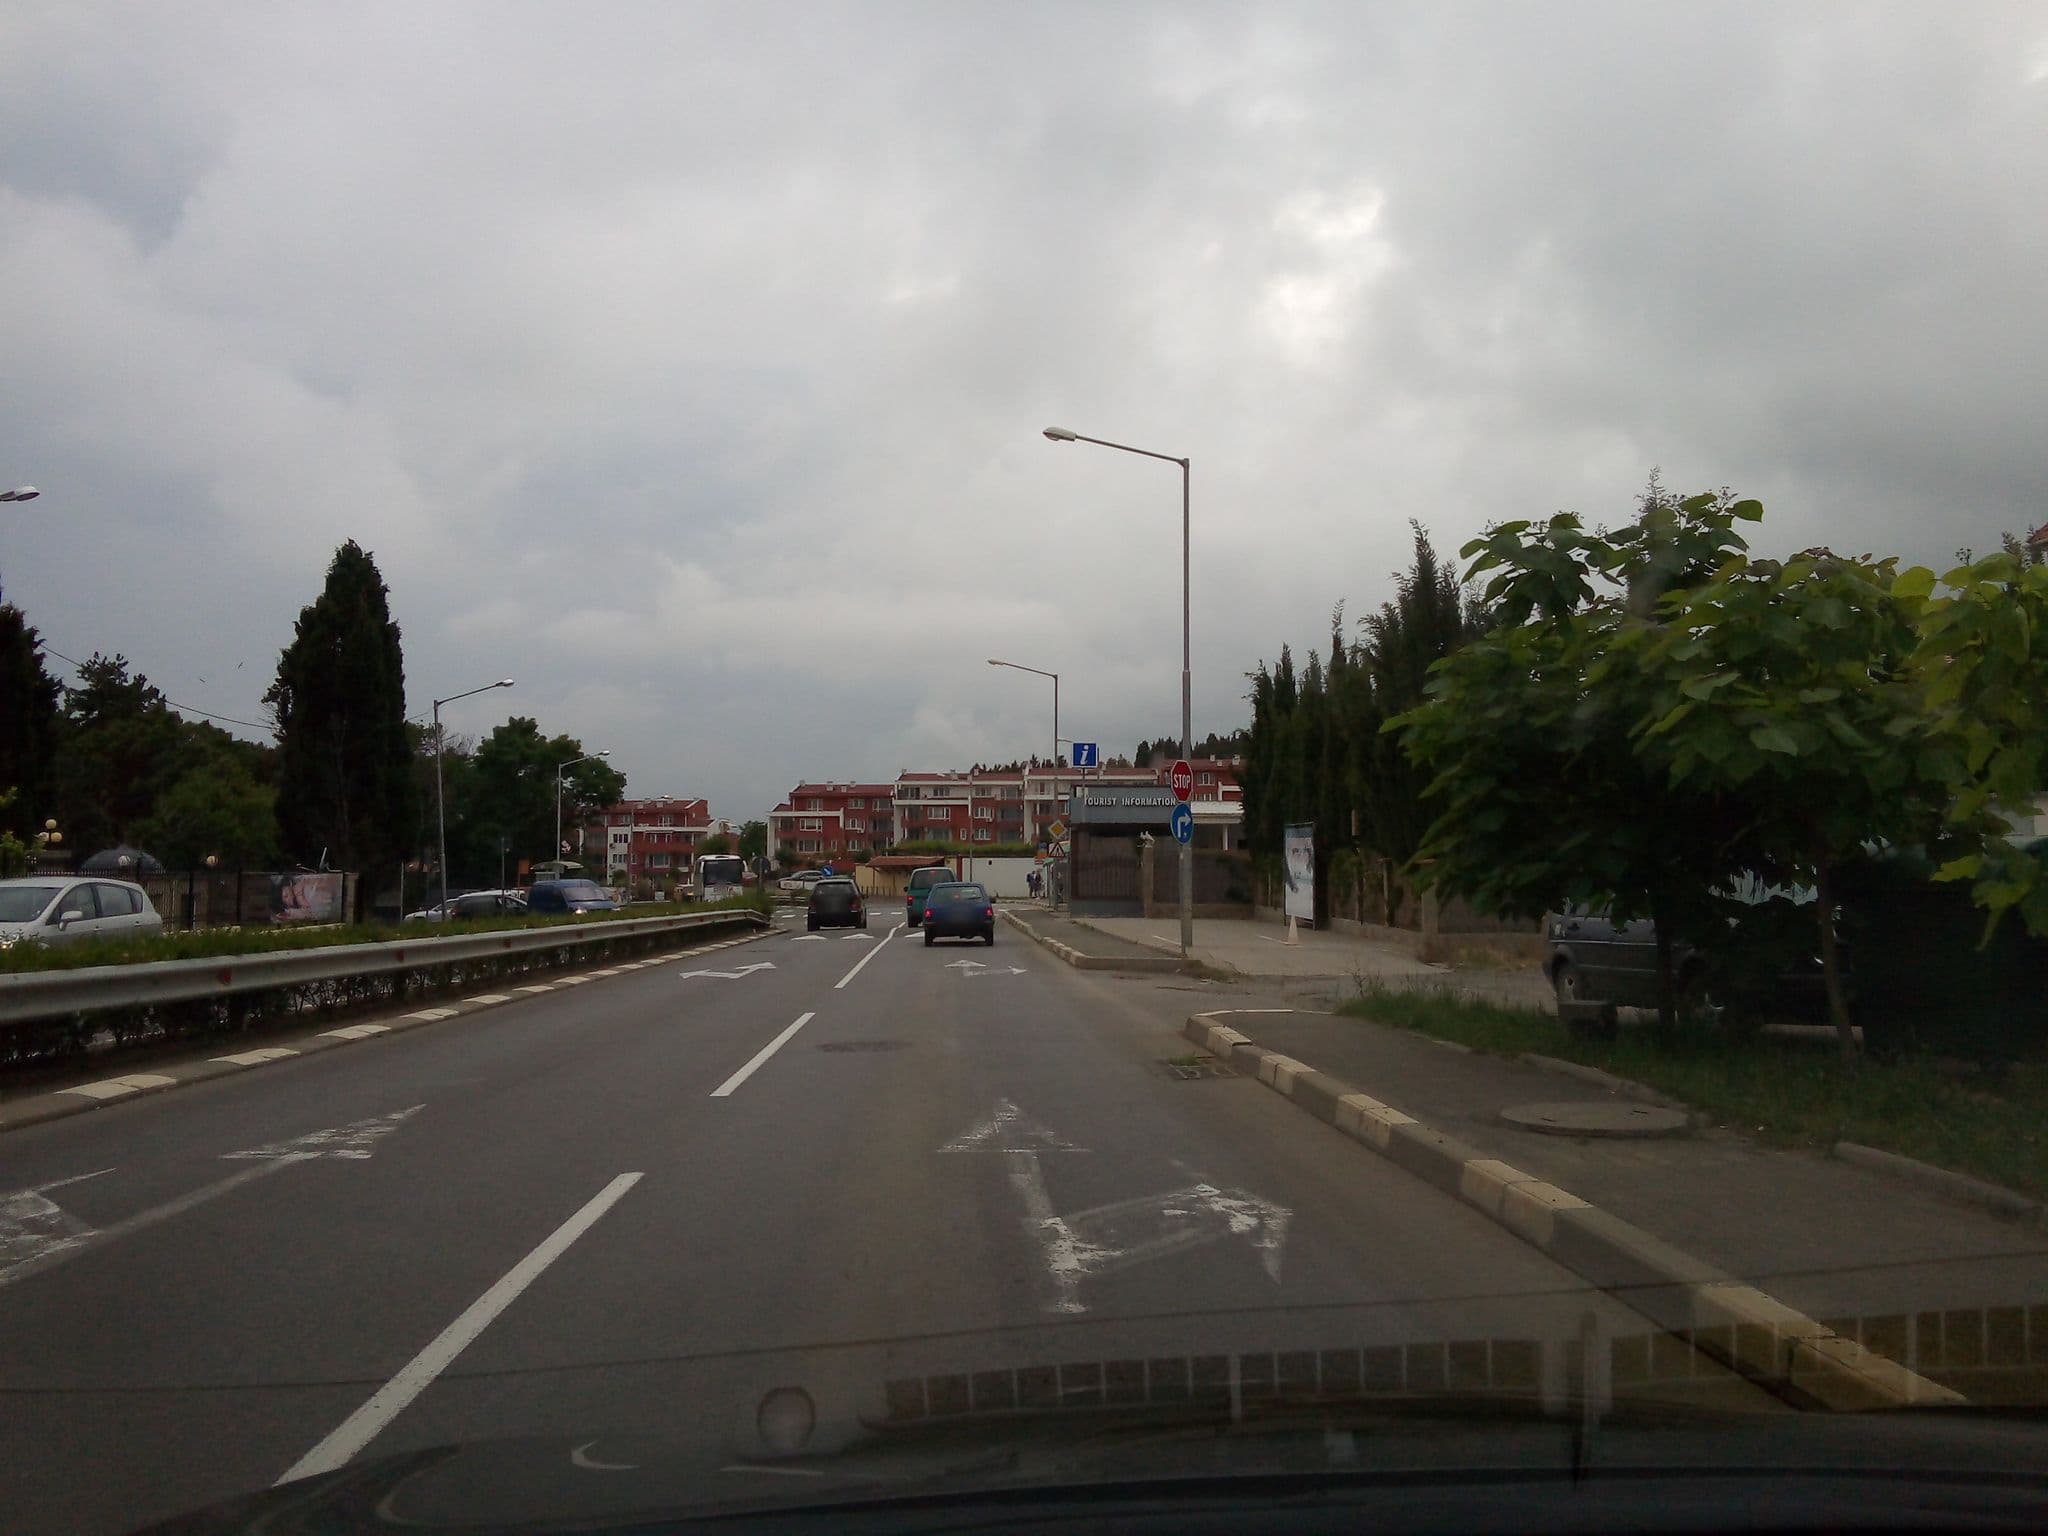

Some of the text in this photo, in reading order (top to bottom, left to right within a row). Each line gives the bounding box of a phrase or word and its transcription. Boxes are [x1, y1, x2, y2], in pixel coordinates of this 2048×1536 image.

[1079, 744, 1089, 765] i
[1173, 774, 1191, 789] STOP
[1121, 797, 1176, 806] INFORMATION
